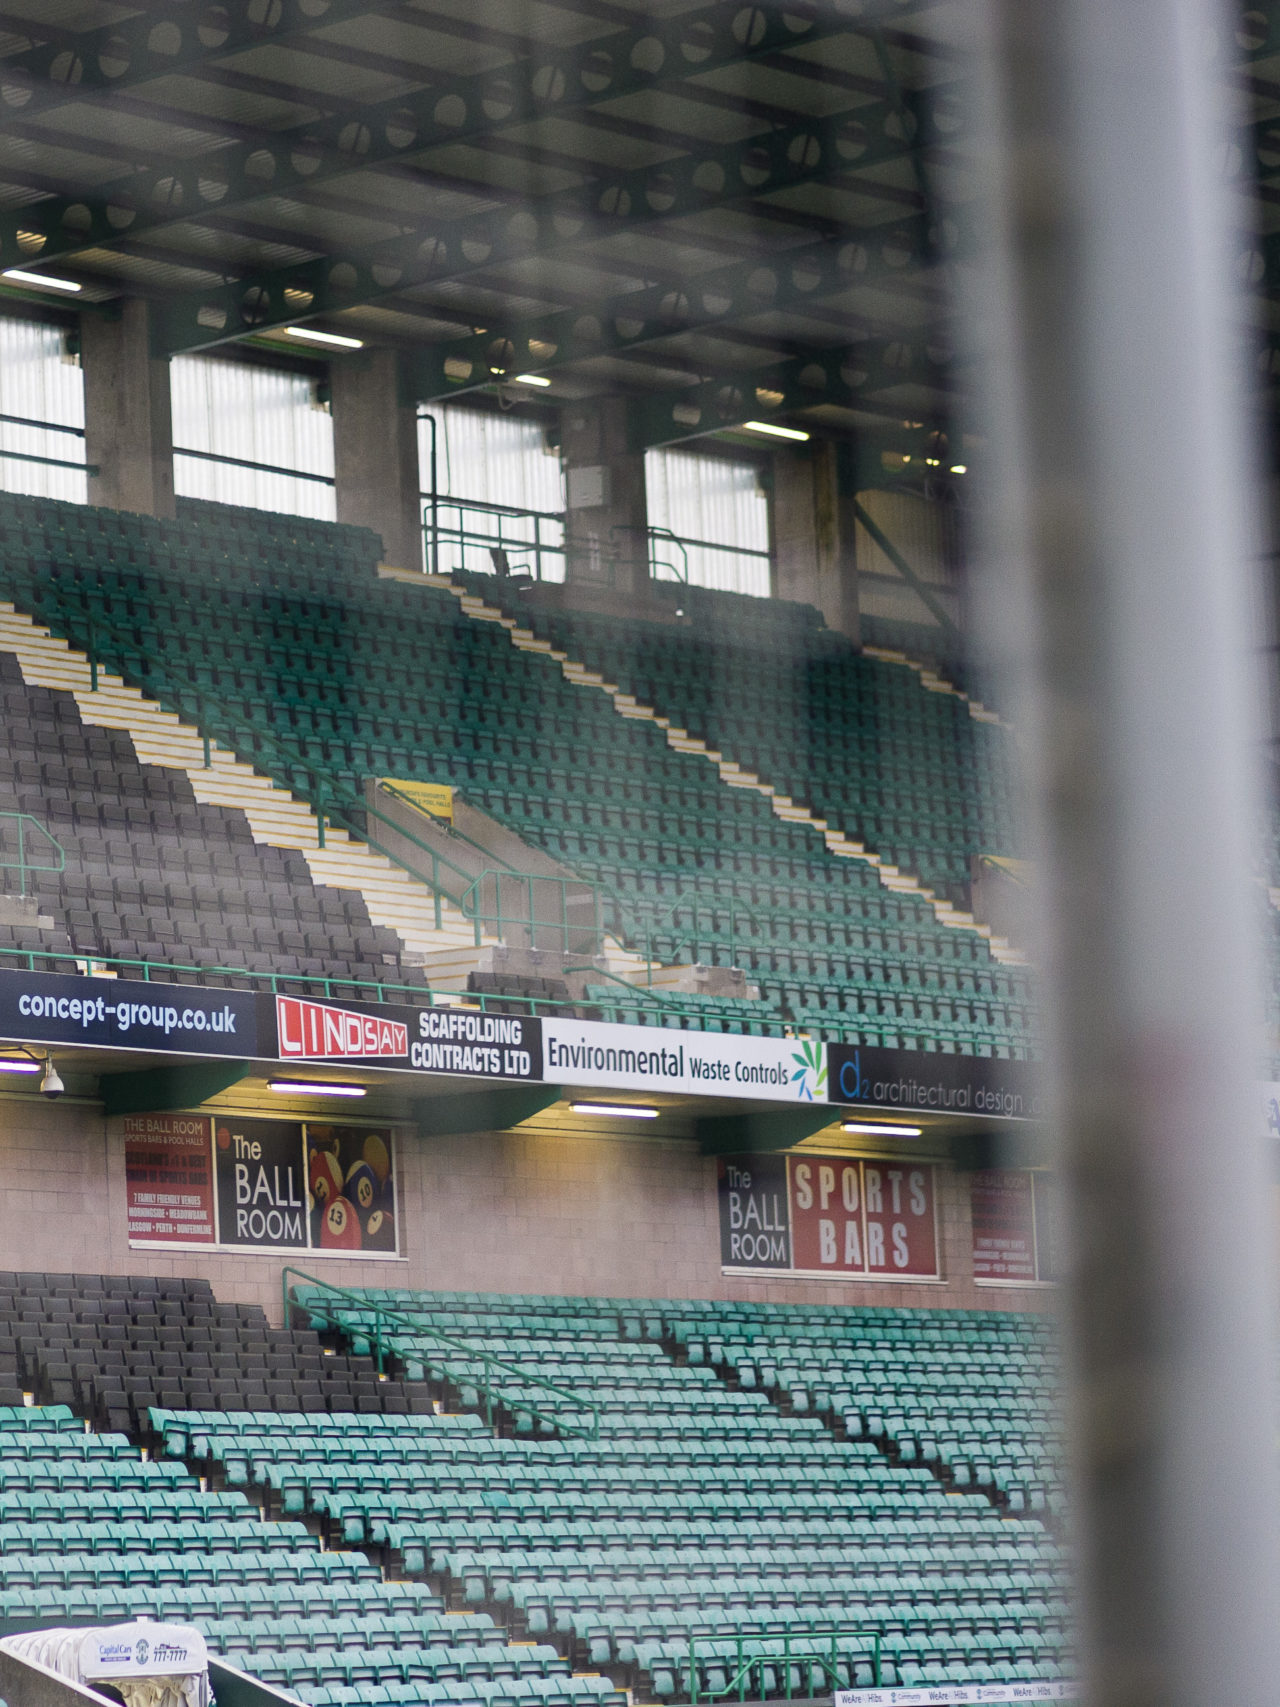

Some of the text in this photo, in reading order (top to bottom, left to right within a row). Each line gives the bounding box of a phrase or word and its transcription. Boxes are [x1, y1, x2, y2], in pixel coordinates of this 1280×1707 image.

[18, 994, 236, 1034] concept-group.co.uk
[280, 1002, 406, 1053] LINDSAY
[419, 1011, 522, 1045] SCAFFOLDING
[410, 1042, 531, 1076] CONTRACTS LTD
[548, 1037, 789, 1086] Environmental Waste Controls
[873, 1078, 971, 1108] architectural
[975, 1086, 1023, 1117] design
[124, 1118, 203, 1136] THE BALL ROOM
[232, 1135, 262, 1161] The
[235, 1164, 302, 1207] BALL
[359, 1183, 371, 1202] 10
[727, 1166, 752, 1189] The
[794, 1163, 926, 1216] SPORTS
[236, 1209, 303, 1241] ROOM
[329, 1207, 343, 1226] 13
[729, 1192, 786, 1231] BALL
[730, 1234, 787, 1262] ROOM
[820, 1219, 909, 1268] BARS
[99, 1644, 119, 1656] Capital
[153, 1650, 187, 1662] 777-7777
